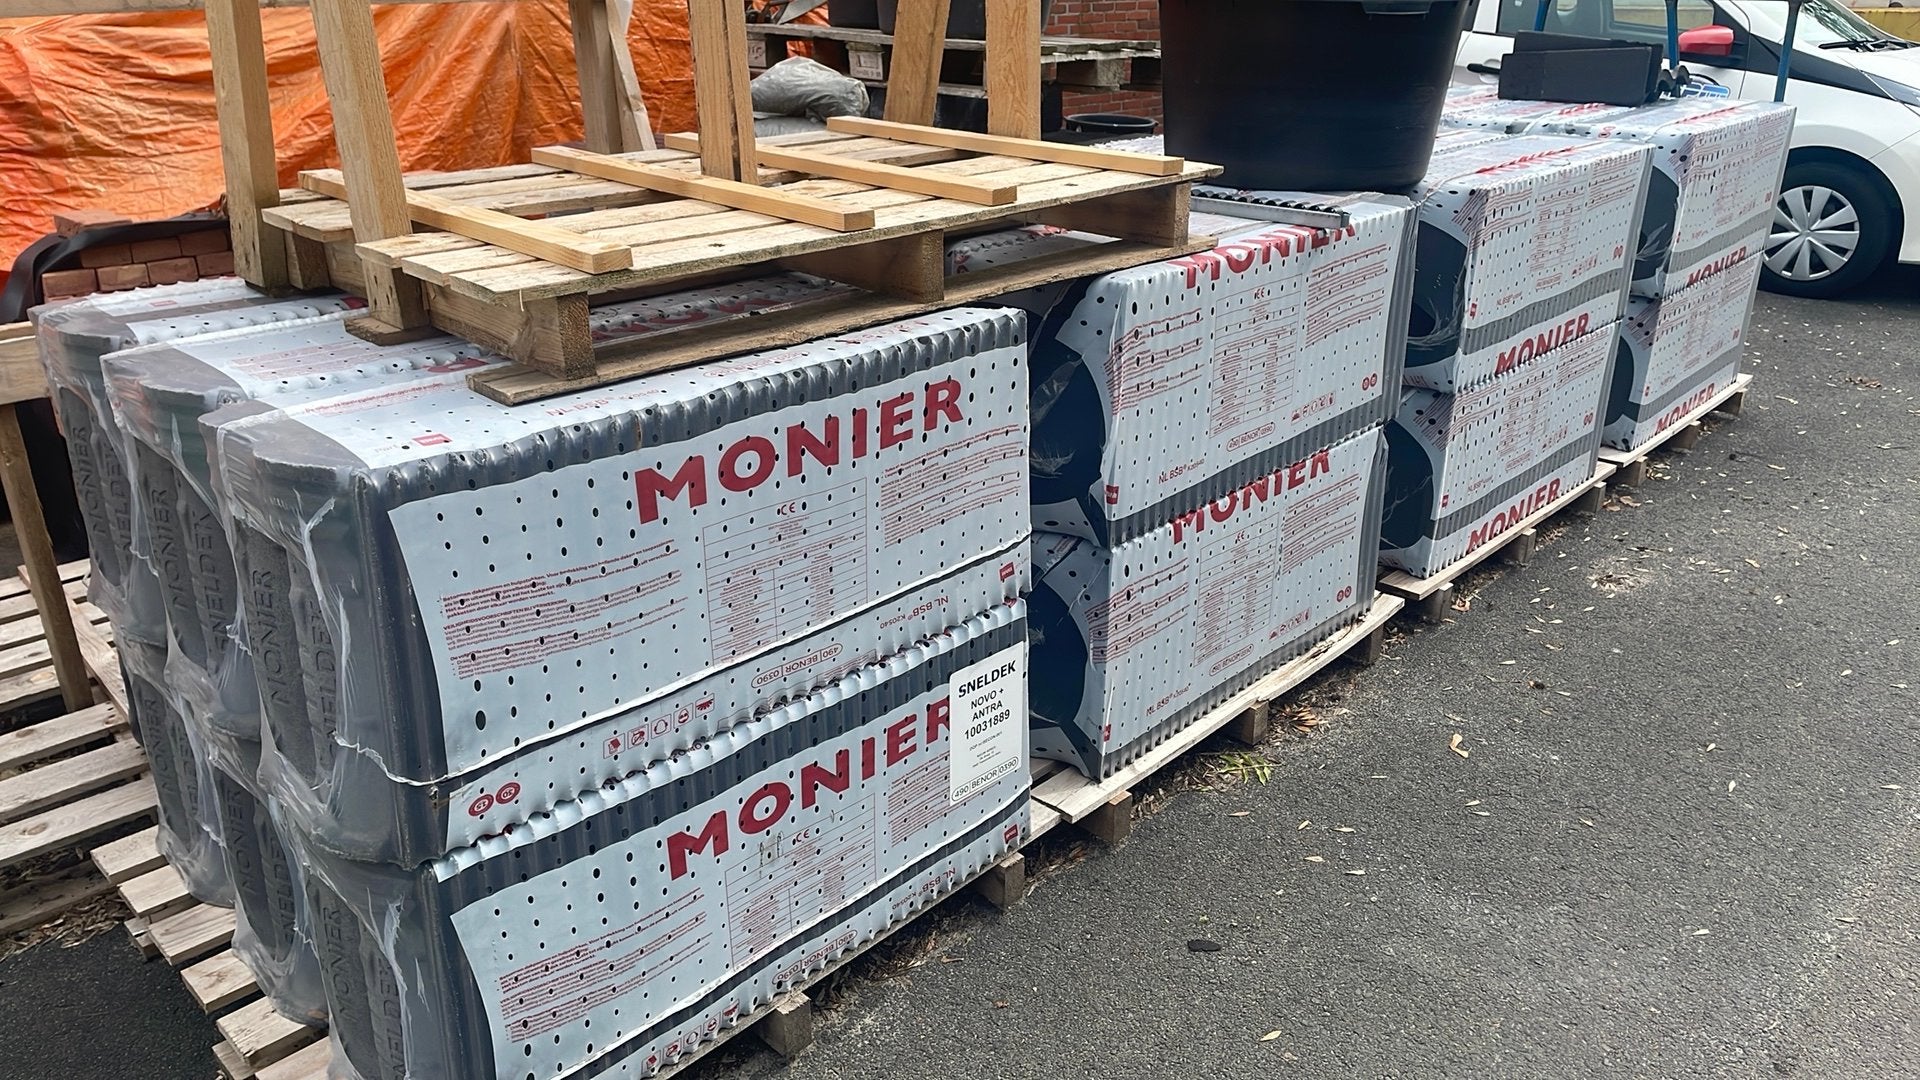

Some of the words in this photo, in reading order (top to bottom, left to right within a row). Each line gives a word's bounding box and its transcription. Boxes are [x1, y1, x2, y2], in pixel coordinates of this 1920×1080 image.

[1494, 312, 1589, 377] MONIER
[1655, 383, 1715, 436] MONIER
[633, 378, 964, 525] MONIER
[779, 502, 796, 516] CE
[1465, 478, 1561, 555] MONIER
[151, 489, 189, 611] MONIER
[935, 595, 949, 607] NL
[879, 613, 906, 630] K20540
[252, 569, 289, 706] MONIER
[784, 654, 818, 673] BENOR
[822, 646, 839, 658] 490
[756, 670, 780, 685] 0390
[958, 660, 1017, 698] SNELDEK
[970, 690, 997, 709] NOVO
[972, 700, 1003, 722] ANTRA
[964, 709, 1011, 740] 10031889
[666, 694, 950, 881] MONIER
[954, 785, 969, 799] 490
[971, 769, 998, 789] BENOR
[999, 758, 1017, 774] 0390
[795, 828, 809, 843] CE
[943, 867, 956, 879] NL
[803, 944, 834, 967] BENOR
